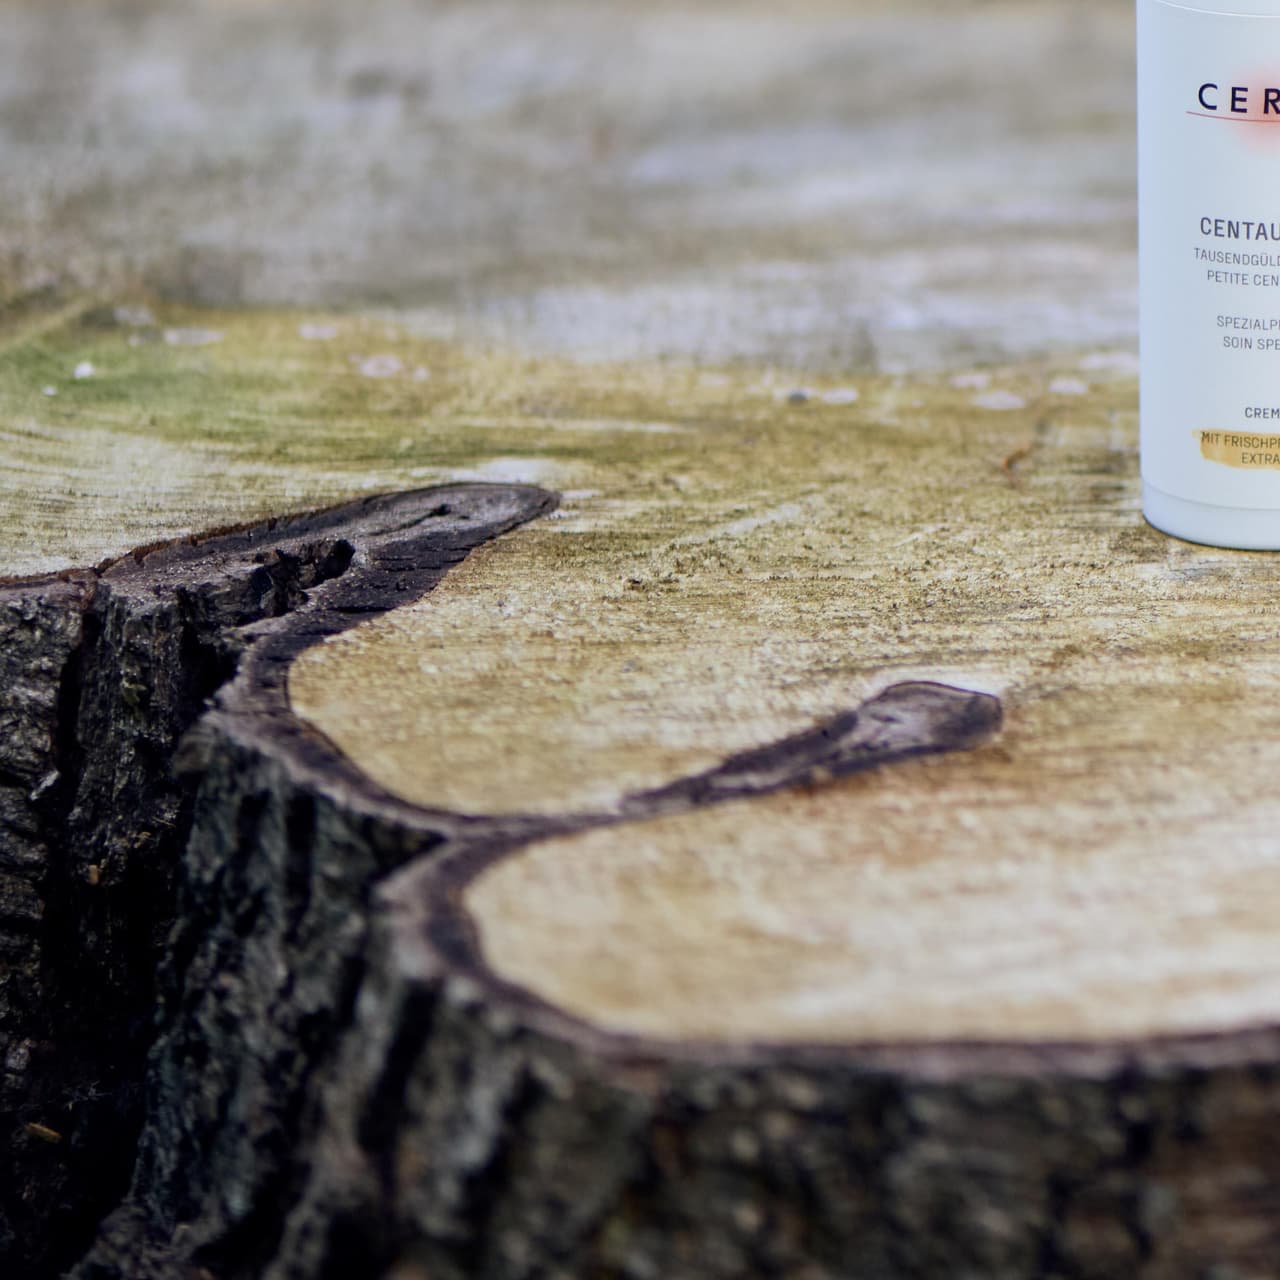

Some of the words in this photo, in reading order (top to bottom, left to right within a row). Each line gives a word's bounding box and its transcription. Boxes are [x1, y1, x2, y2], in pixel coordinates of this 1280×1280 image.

[1207, 269, 1249, 286] PETITE
[1223, 336, 1252, 349] SOIN
[1201, 431, 1221, 443] MIT
